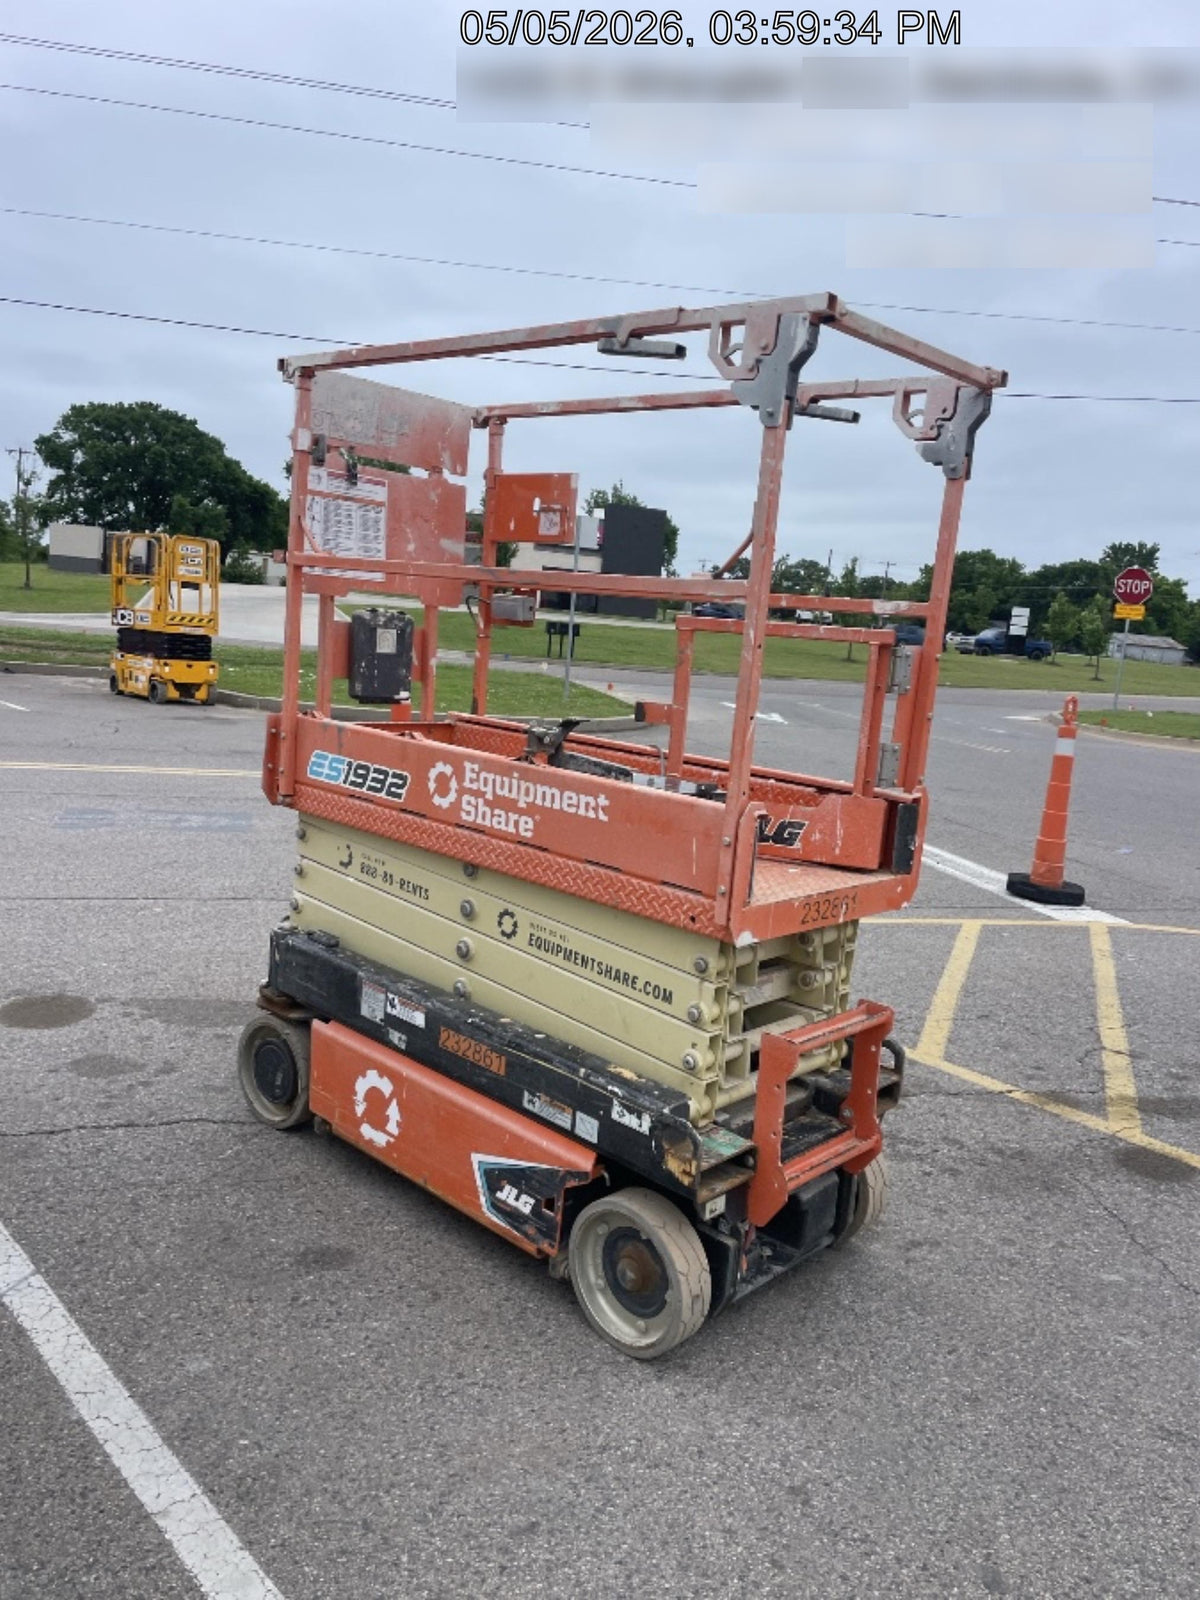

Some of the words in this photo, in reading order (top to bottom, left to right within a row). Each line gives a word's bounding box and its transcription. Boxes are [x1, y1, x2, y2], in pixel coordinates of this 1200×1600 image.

[1118, 579, 1150, 594] STOP
[307, 749, 410, 802] ES1932
[463, 761, 611, 822] Equipment
[460, 794, 535, 838] Share
[756, 814, 809, 848] LG
[528, 933, 674, 1005] EQUIPMENTSHARE.COM
[496, 1184, 536, 1215] JLG
